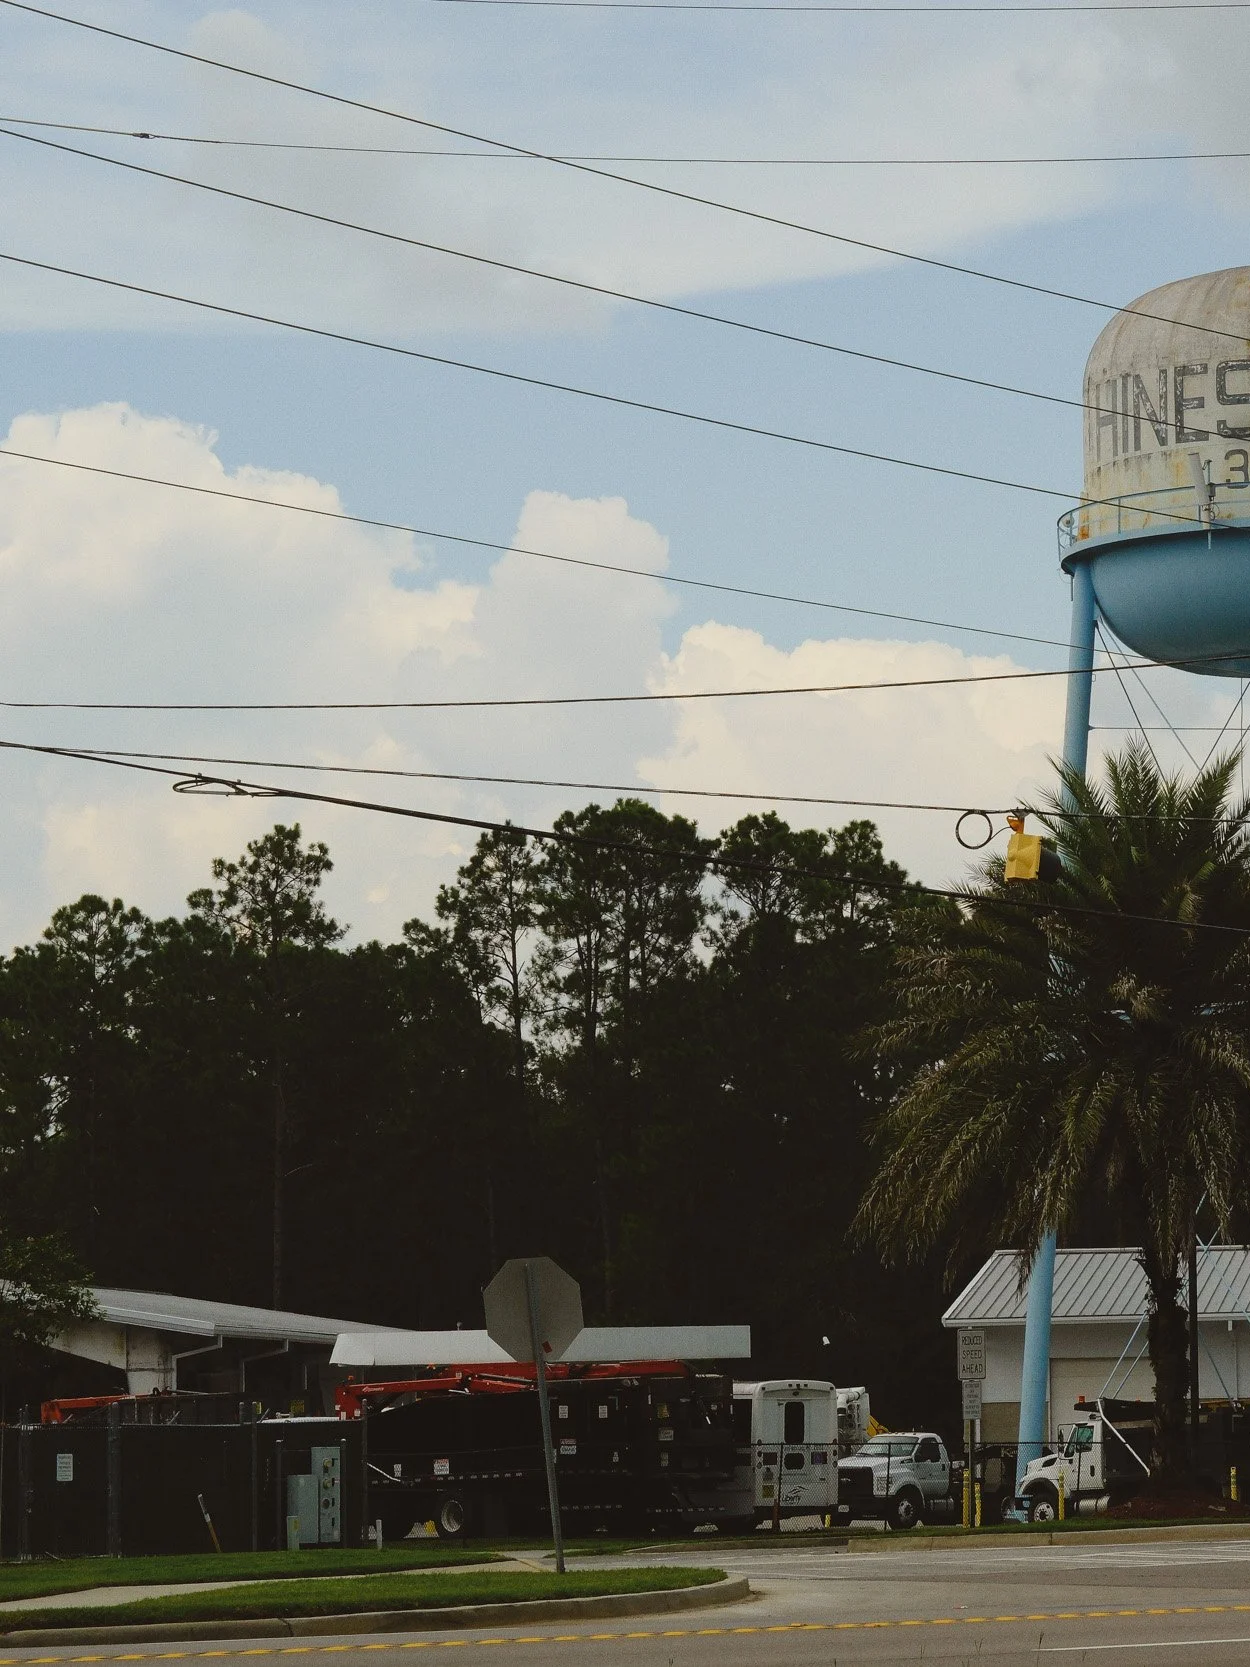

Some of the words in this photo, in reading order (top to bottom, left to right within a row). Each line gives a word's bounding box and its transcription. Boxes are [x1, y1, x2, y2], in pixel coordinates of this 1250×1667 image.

[961, 1335, 982, 1346] REDUCED
[961, 1349, 982, 1360] SPEED
[961, 1364, 982, 1374] AHEAD
